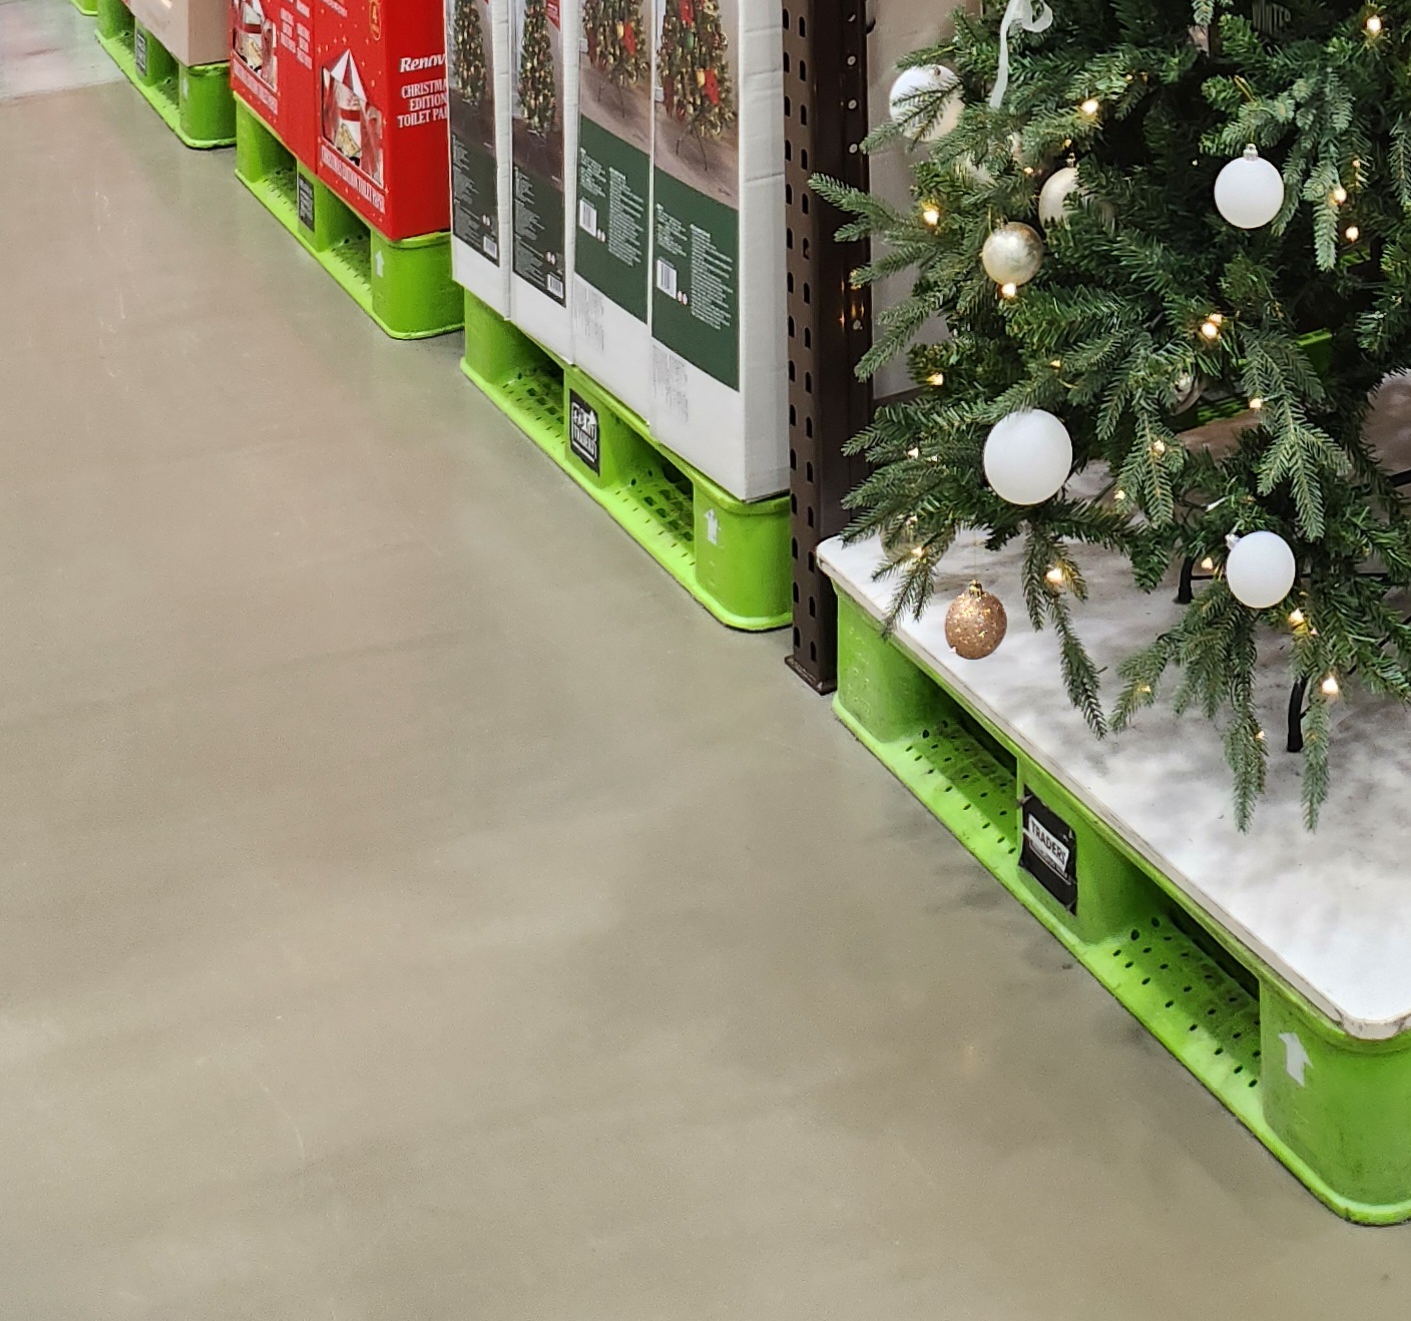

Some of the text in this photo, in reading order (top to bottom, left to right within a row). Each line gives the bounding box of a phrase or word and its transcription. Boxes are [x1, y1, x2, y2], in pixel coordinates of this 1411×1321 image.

[400, 54, 445, 73] Renov
[397, 110, 430, 128] TOILET
[1031, 820, 1066, 865] TRADERS
